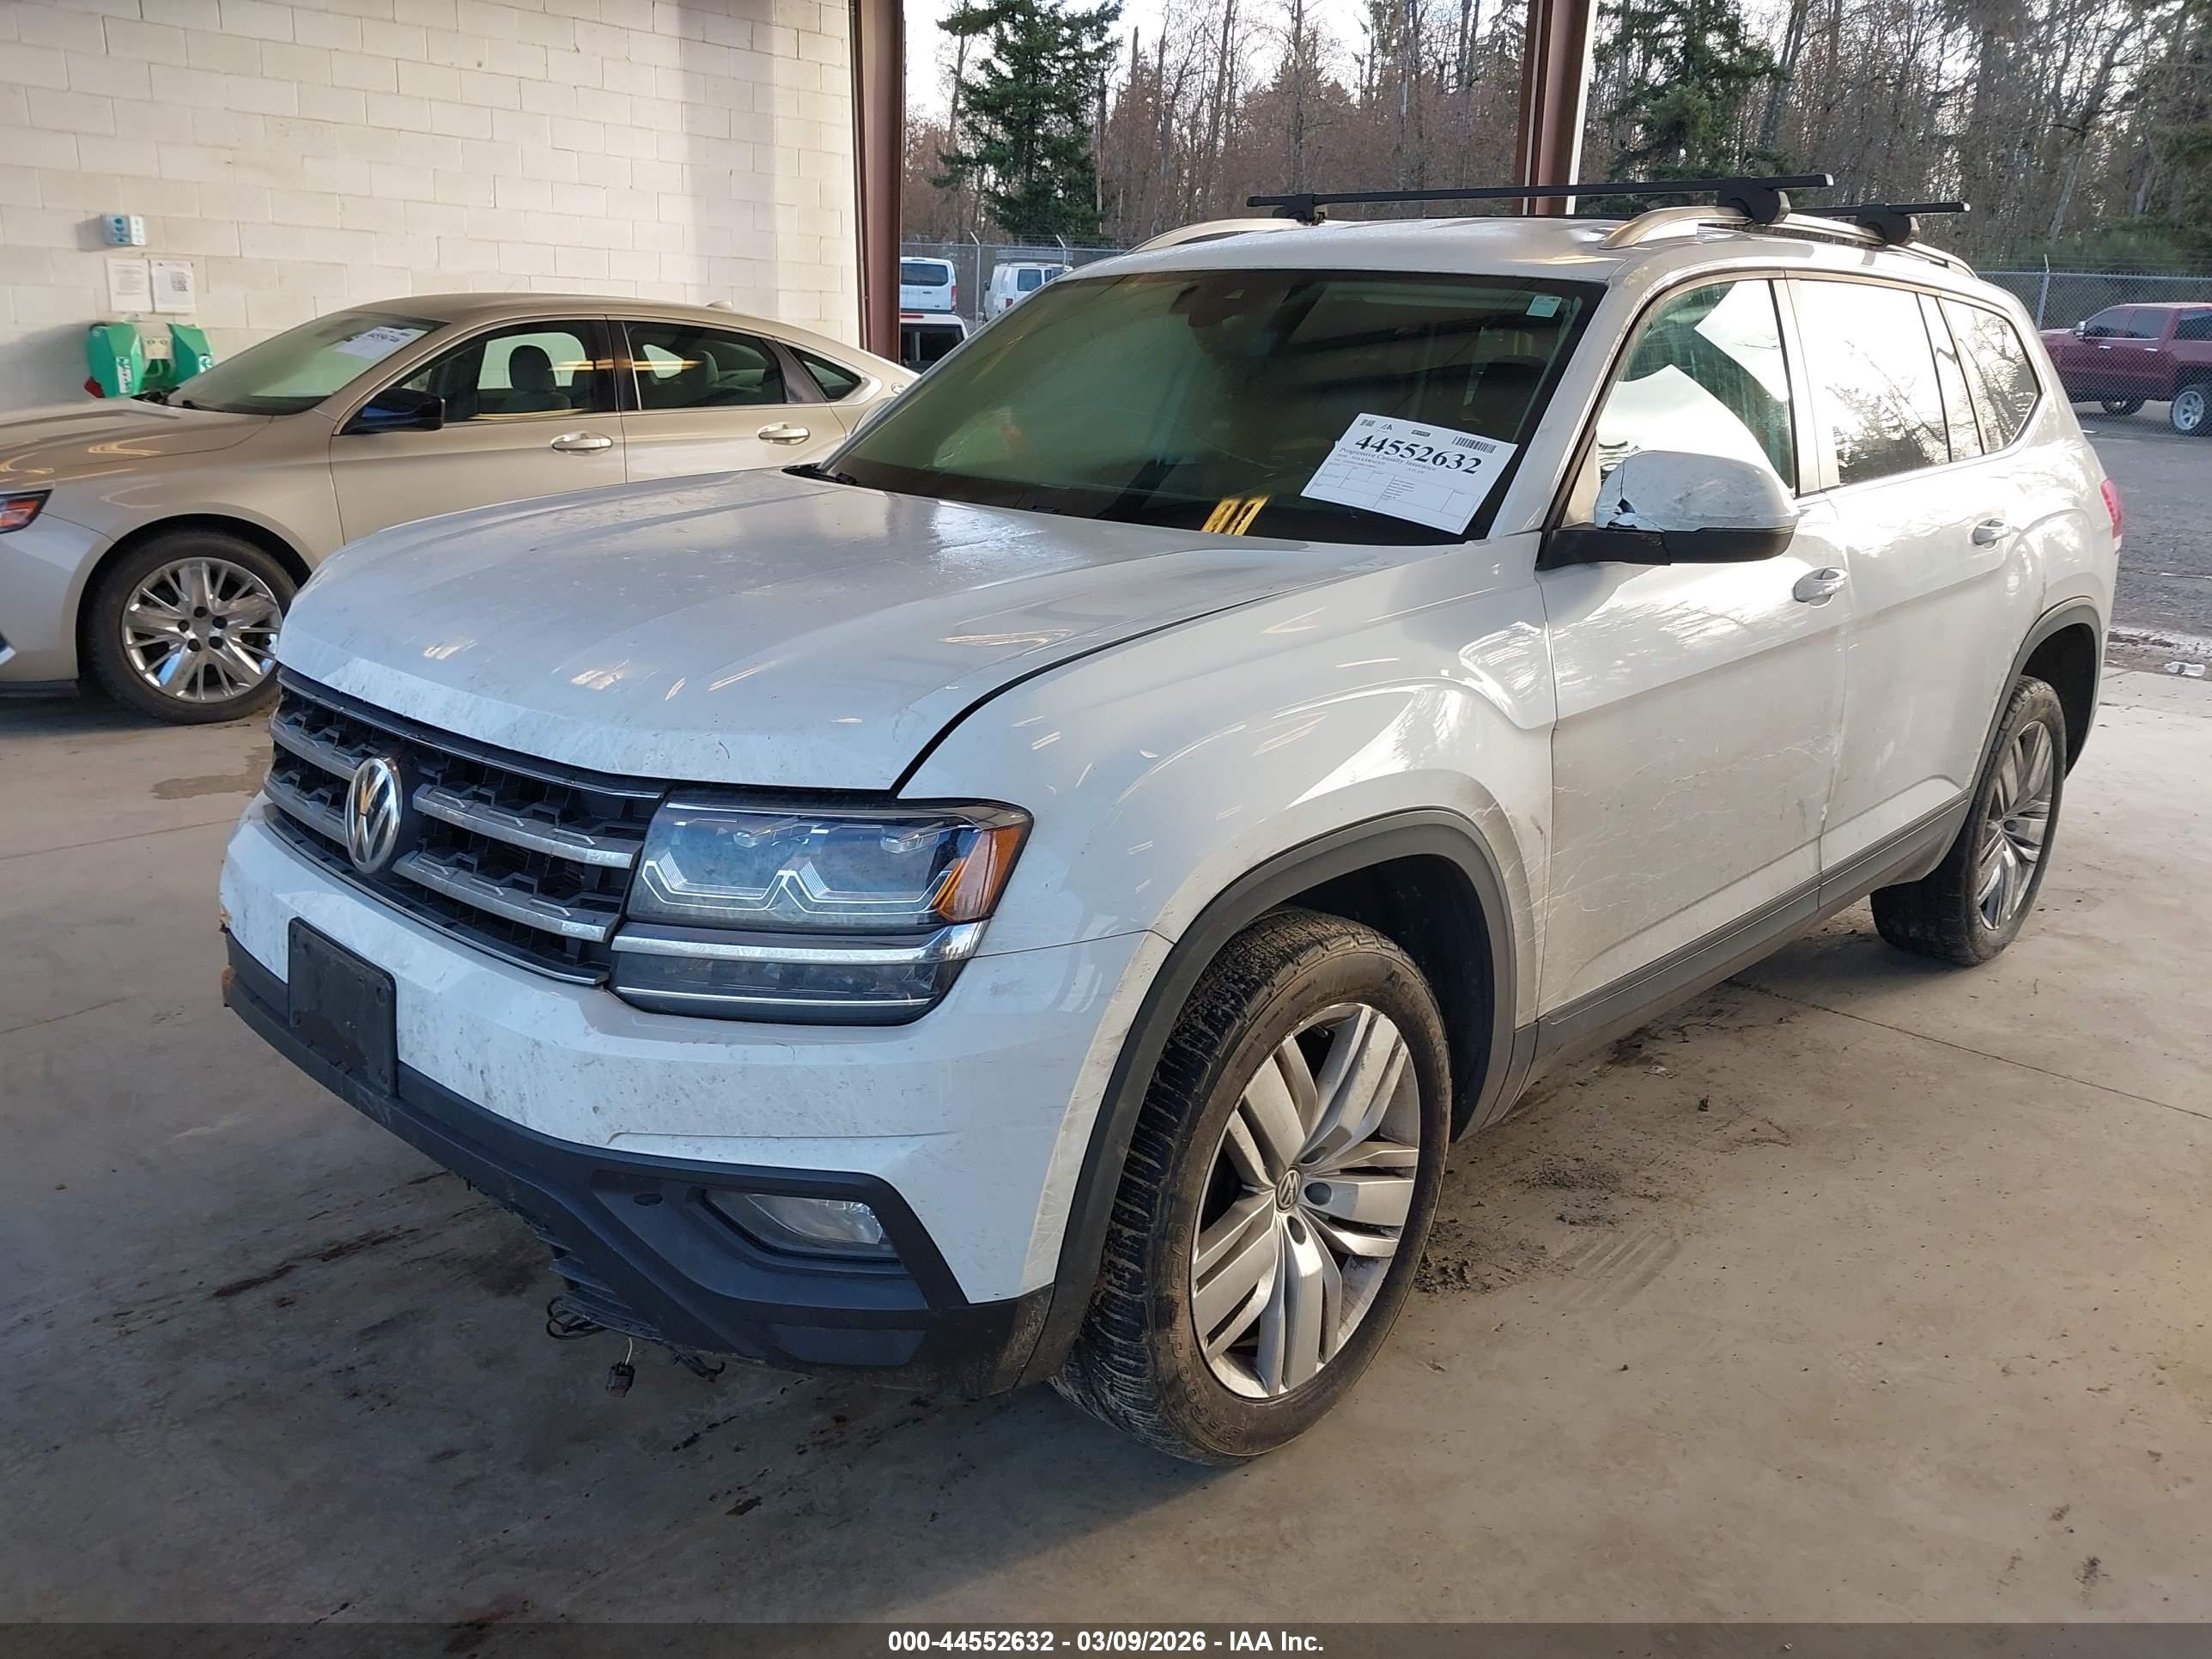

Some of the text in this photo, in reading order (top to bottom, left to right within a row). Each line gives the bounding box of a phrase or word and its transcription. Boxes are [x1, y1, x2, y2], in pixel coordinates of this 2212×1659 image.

[1339, 447, 1376, 459] Progressive
[1376, 453, 1405, 465] Casualty
[1405, 459, 1438, 471] Insurance
[1354, 434, 1483, 475] 44552632
